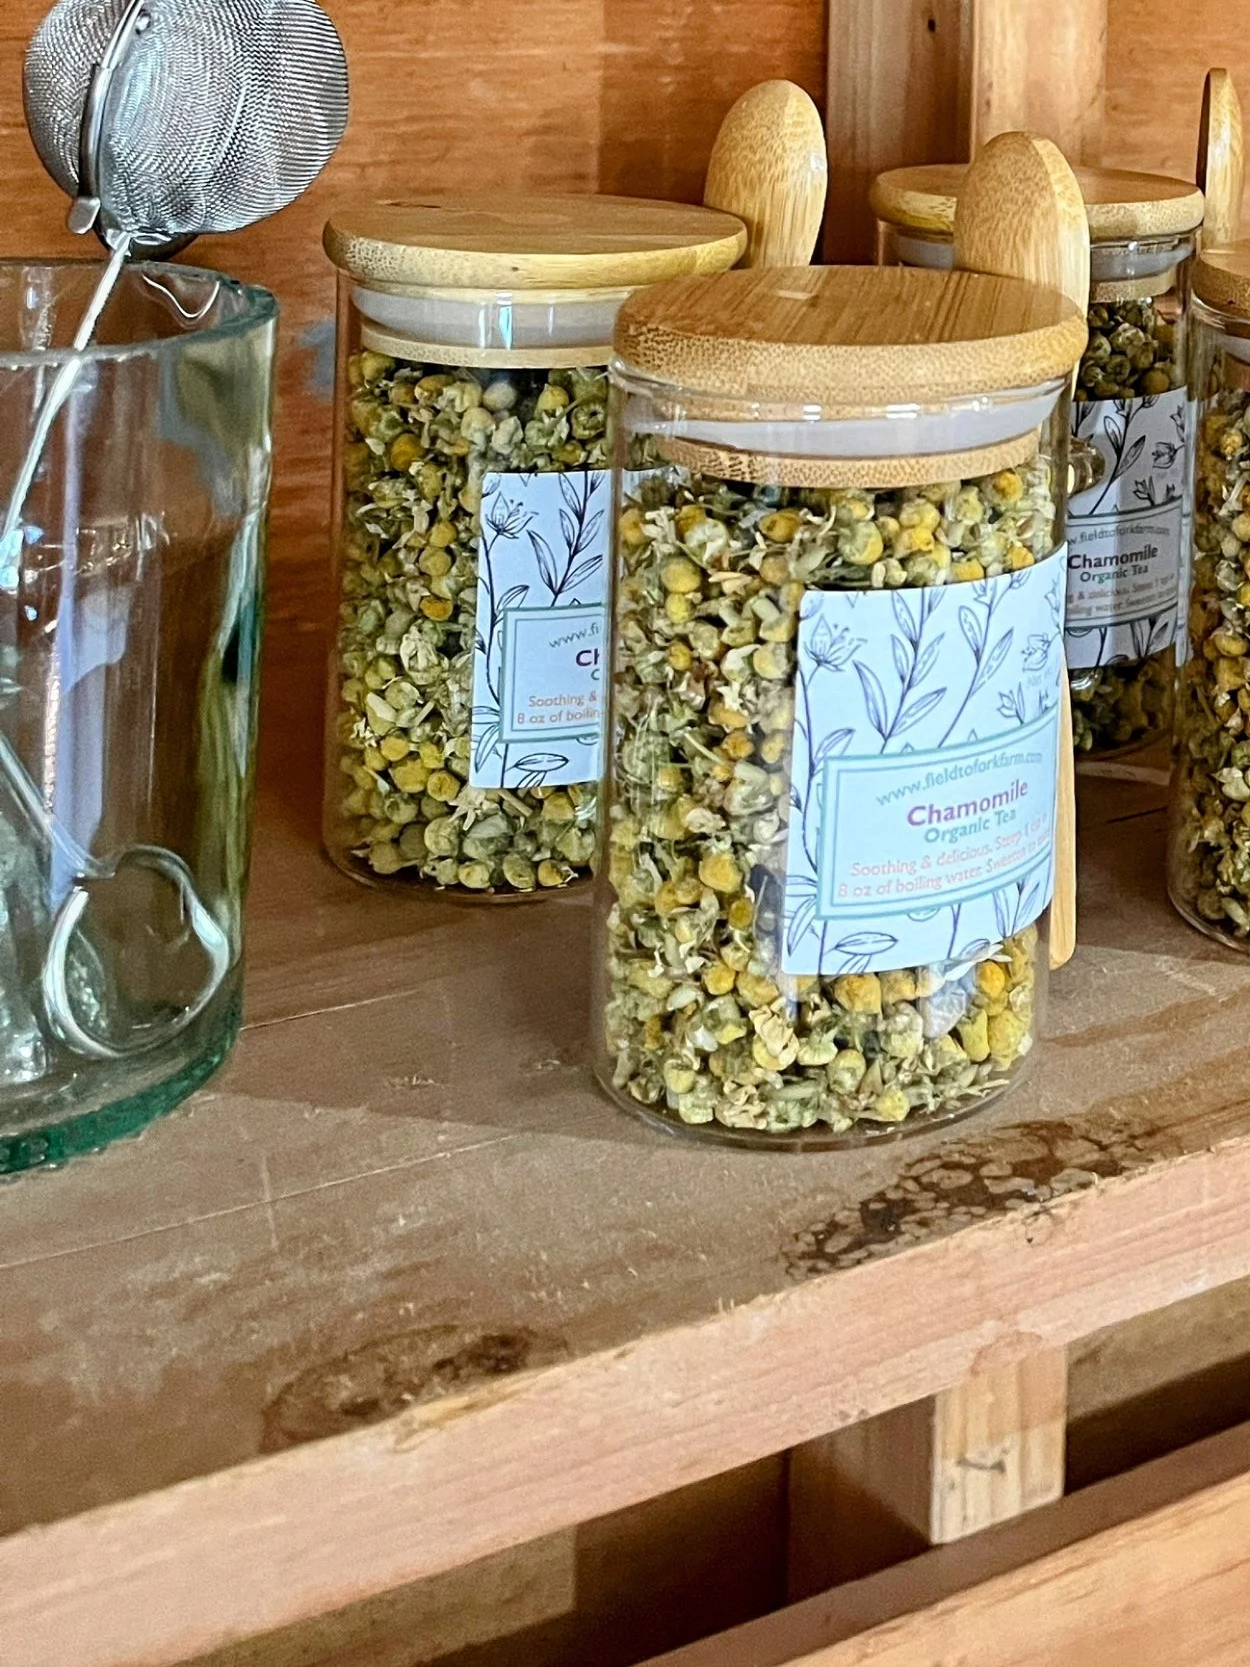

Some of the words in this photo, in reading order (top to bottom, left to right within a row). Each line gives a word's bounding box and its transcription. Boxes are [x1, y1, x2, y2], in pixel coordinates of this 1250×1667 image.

[1067, 544, 1158, 569] Chamomile
[1080, 568, 1128, 584] Organic
[1131, 564, 1149, 576] Tea
[528, 692, 585, 708] Soothing
[588, 690, 597, 702] &
[517, 713, 525, 725] 8
[529, 714, 545, 724] oz
[550, 709, 564, 723] of
[566, 705, 600, 722] boilin
[906, 779, 1028, 827] Chamomile
[924, 816, 990, 844] Organic
[994, 808, 1016, 827] Tea
[851, 857, 917, 878] Soothing
[920, 854, 932, 870] &
[936, 841, 993, 865] delicious.
[838, 882, 848, 898] 8
[853, 884, 871, 897] oz
[876, 879, 893, 895] of
[896, 872, 943, 894] boiling
